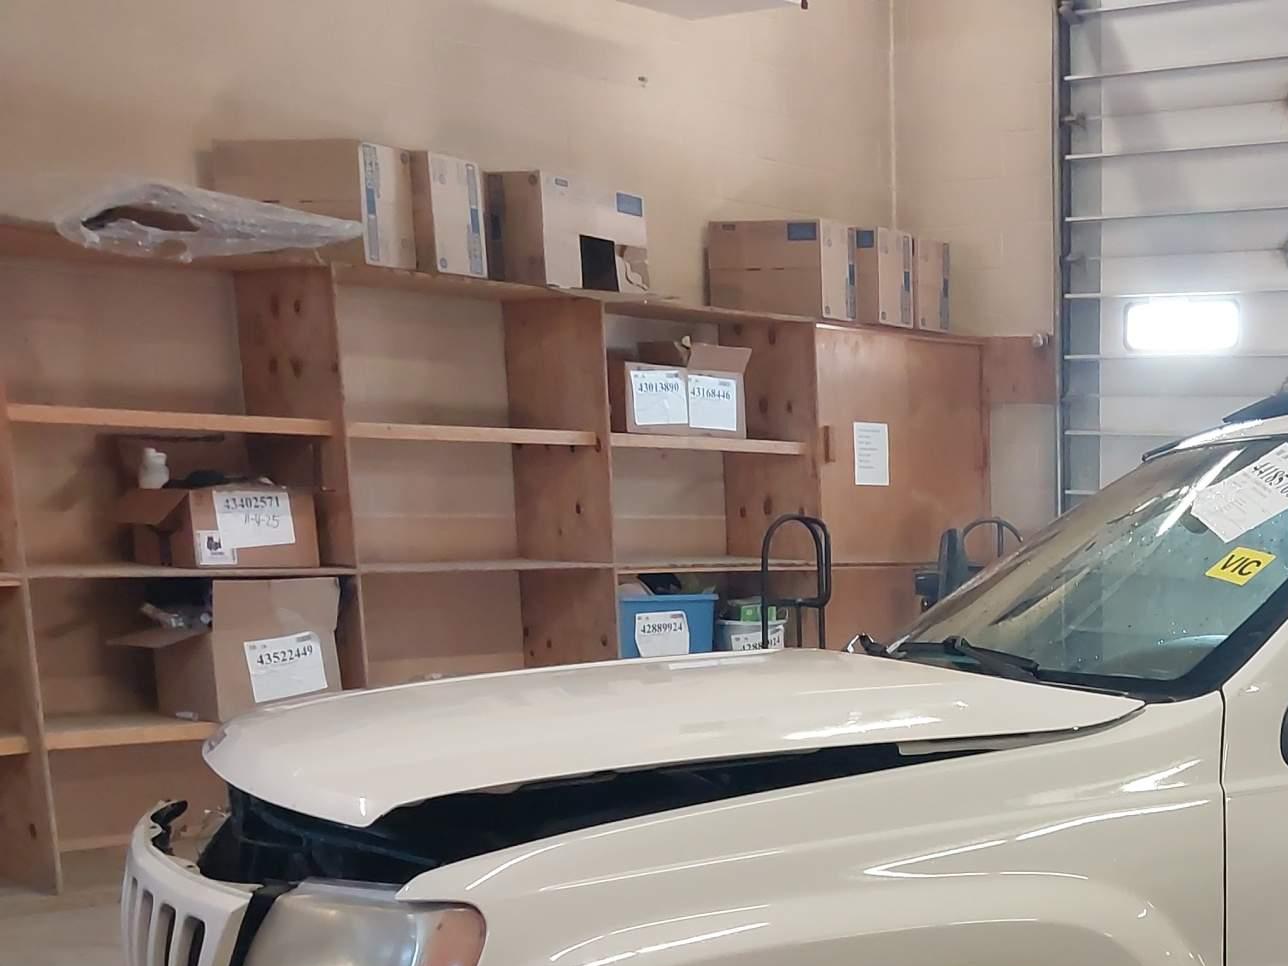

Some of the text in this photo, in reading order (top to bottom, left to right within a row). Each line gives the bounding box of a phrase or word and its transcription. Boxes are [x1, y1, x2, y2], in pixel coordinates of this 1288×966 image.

[639, 382, 680, 393] 43013890
[224, 495, 280, 510] 43402571
[1219, 553, 1262, 577] VIC
[640, 622, 683, 635] 42889924
[257, 645, 313, 664] 43522449
